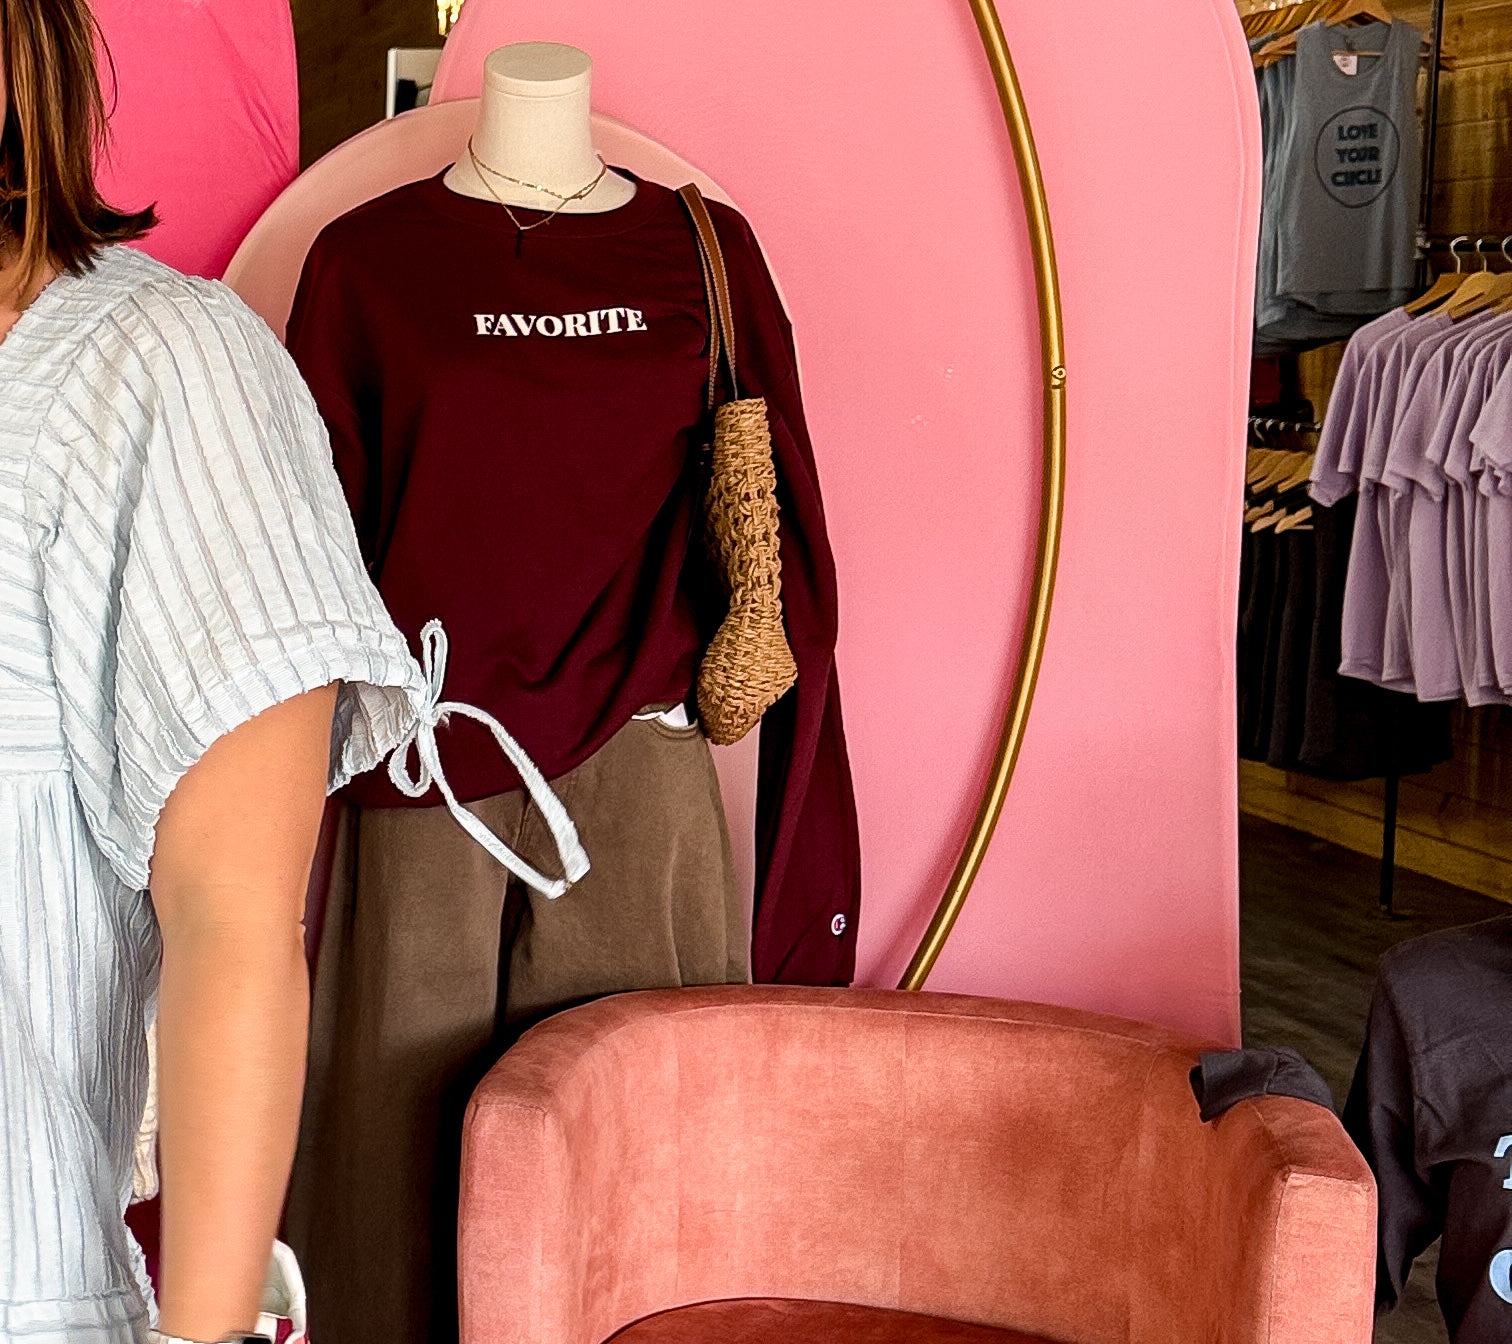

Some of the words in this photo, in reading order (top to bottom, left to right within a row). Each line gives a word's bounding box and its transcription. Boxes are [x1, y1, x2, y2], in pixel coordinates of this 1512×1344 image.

[1338, 123, 1379, 141] LOVE
[1335, 146, 1380, 163] YOUR
[473, 307, 648, 337] FAVORITE
